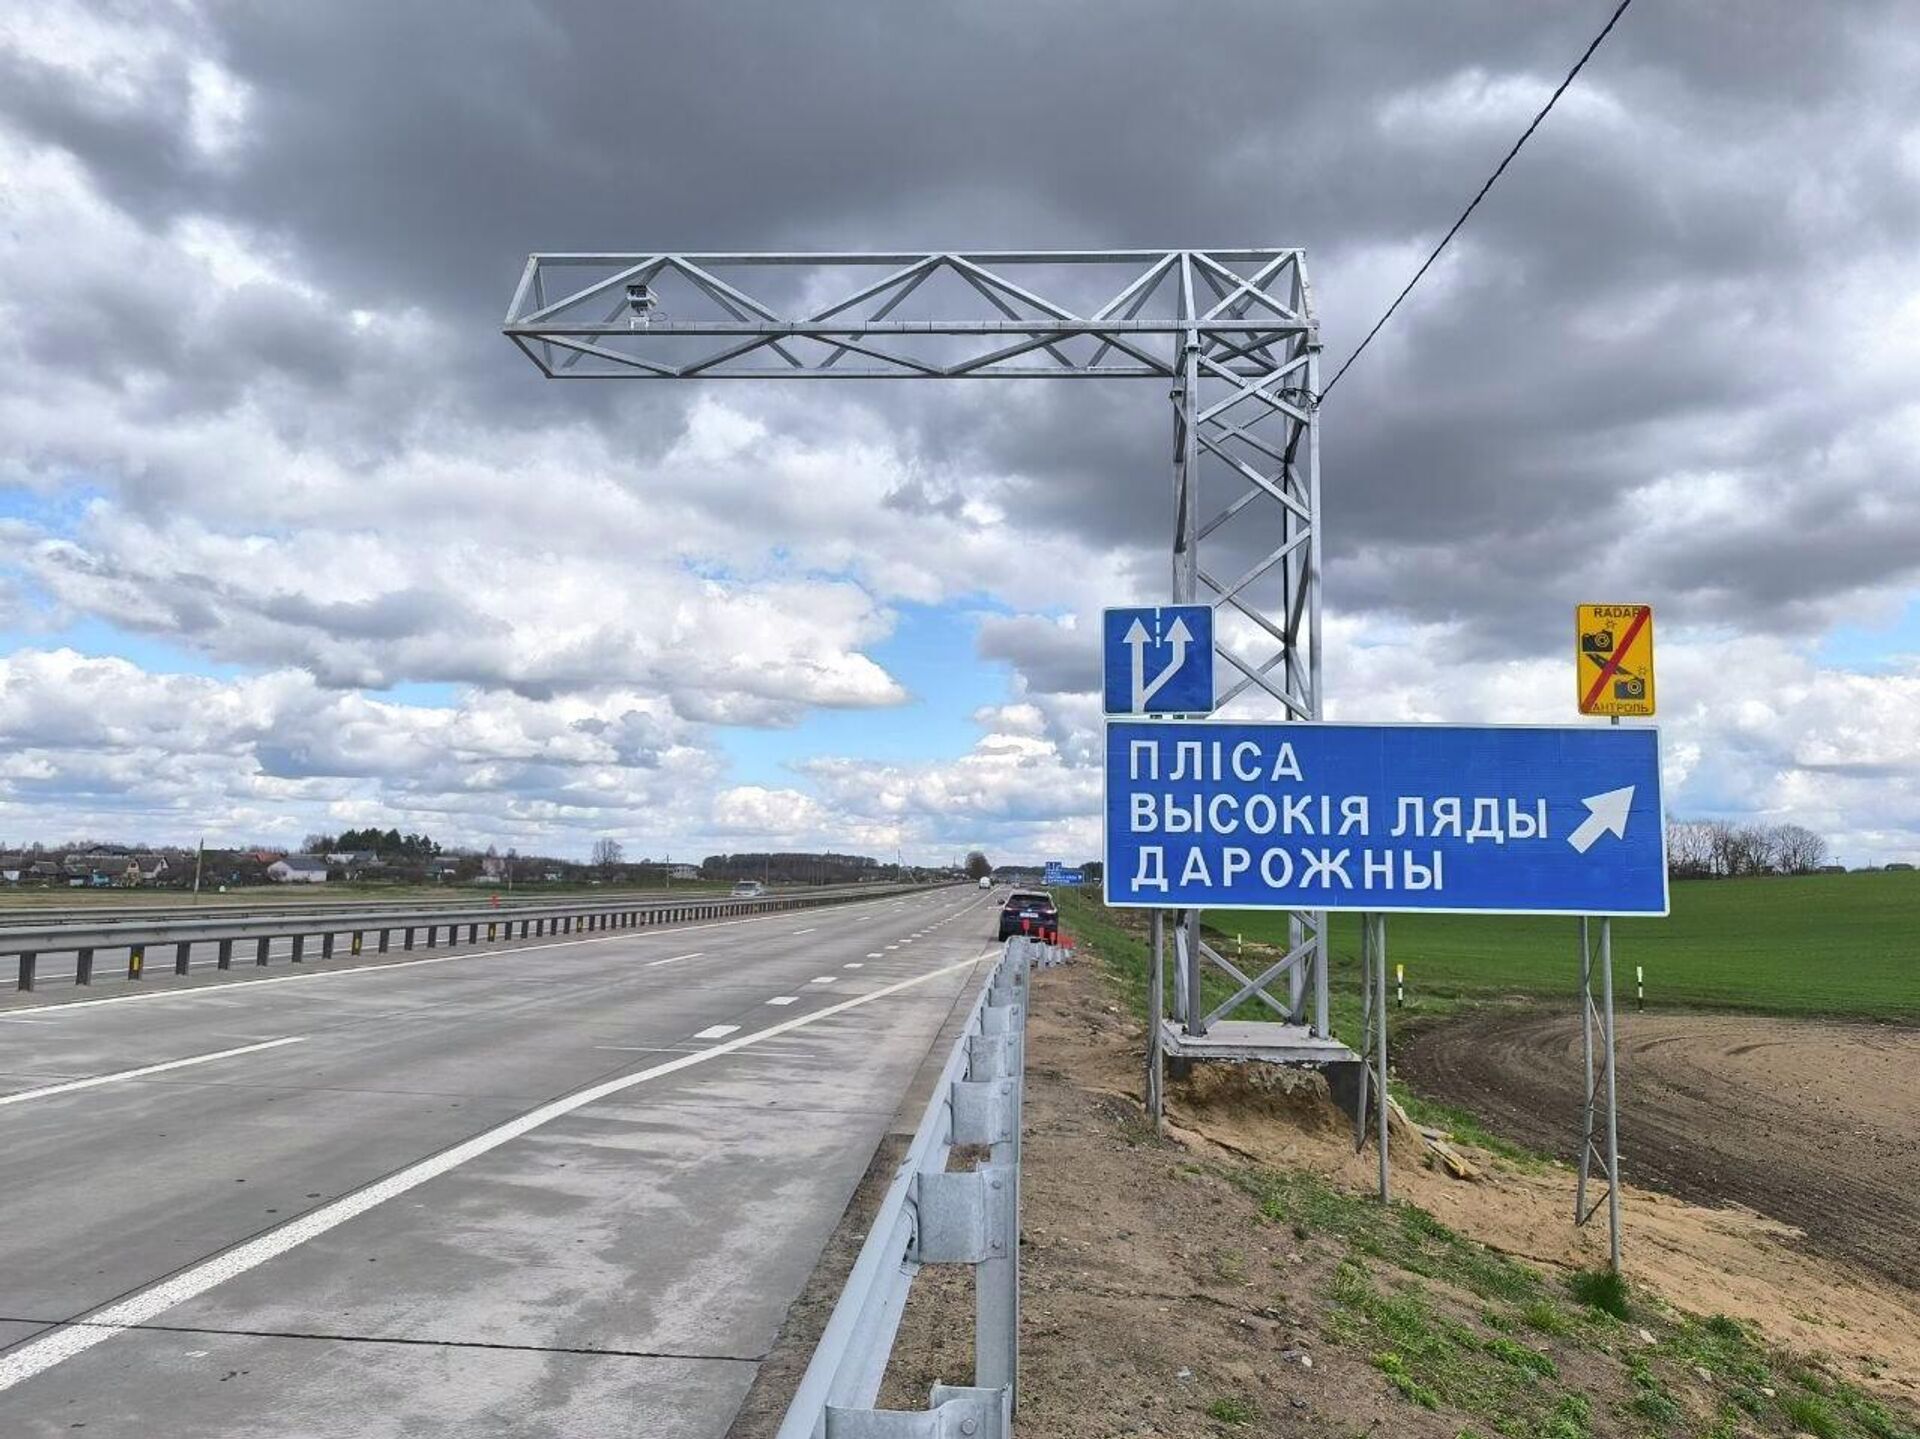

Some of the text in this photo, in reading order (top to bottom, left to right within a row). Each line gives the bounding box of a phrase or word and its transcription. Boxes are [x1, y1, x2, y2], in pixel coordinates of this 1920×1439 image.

[1585, 702, 1649, 713] АНТРОЛЬ
[1130, 740, 1303, 782] ПЛІСА
[1130, 792, 1548, 844] ВЫСОКІЯ ЛЯДЫ
[1131, 846, 1443, 893] ДАРОЖНЫ
